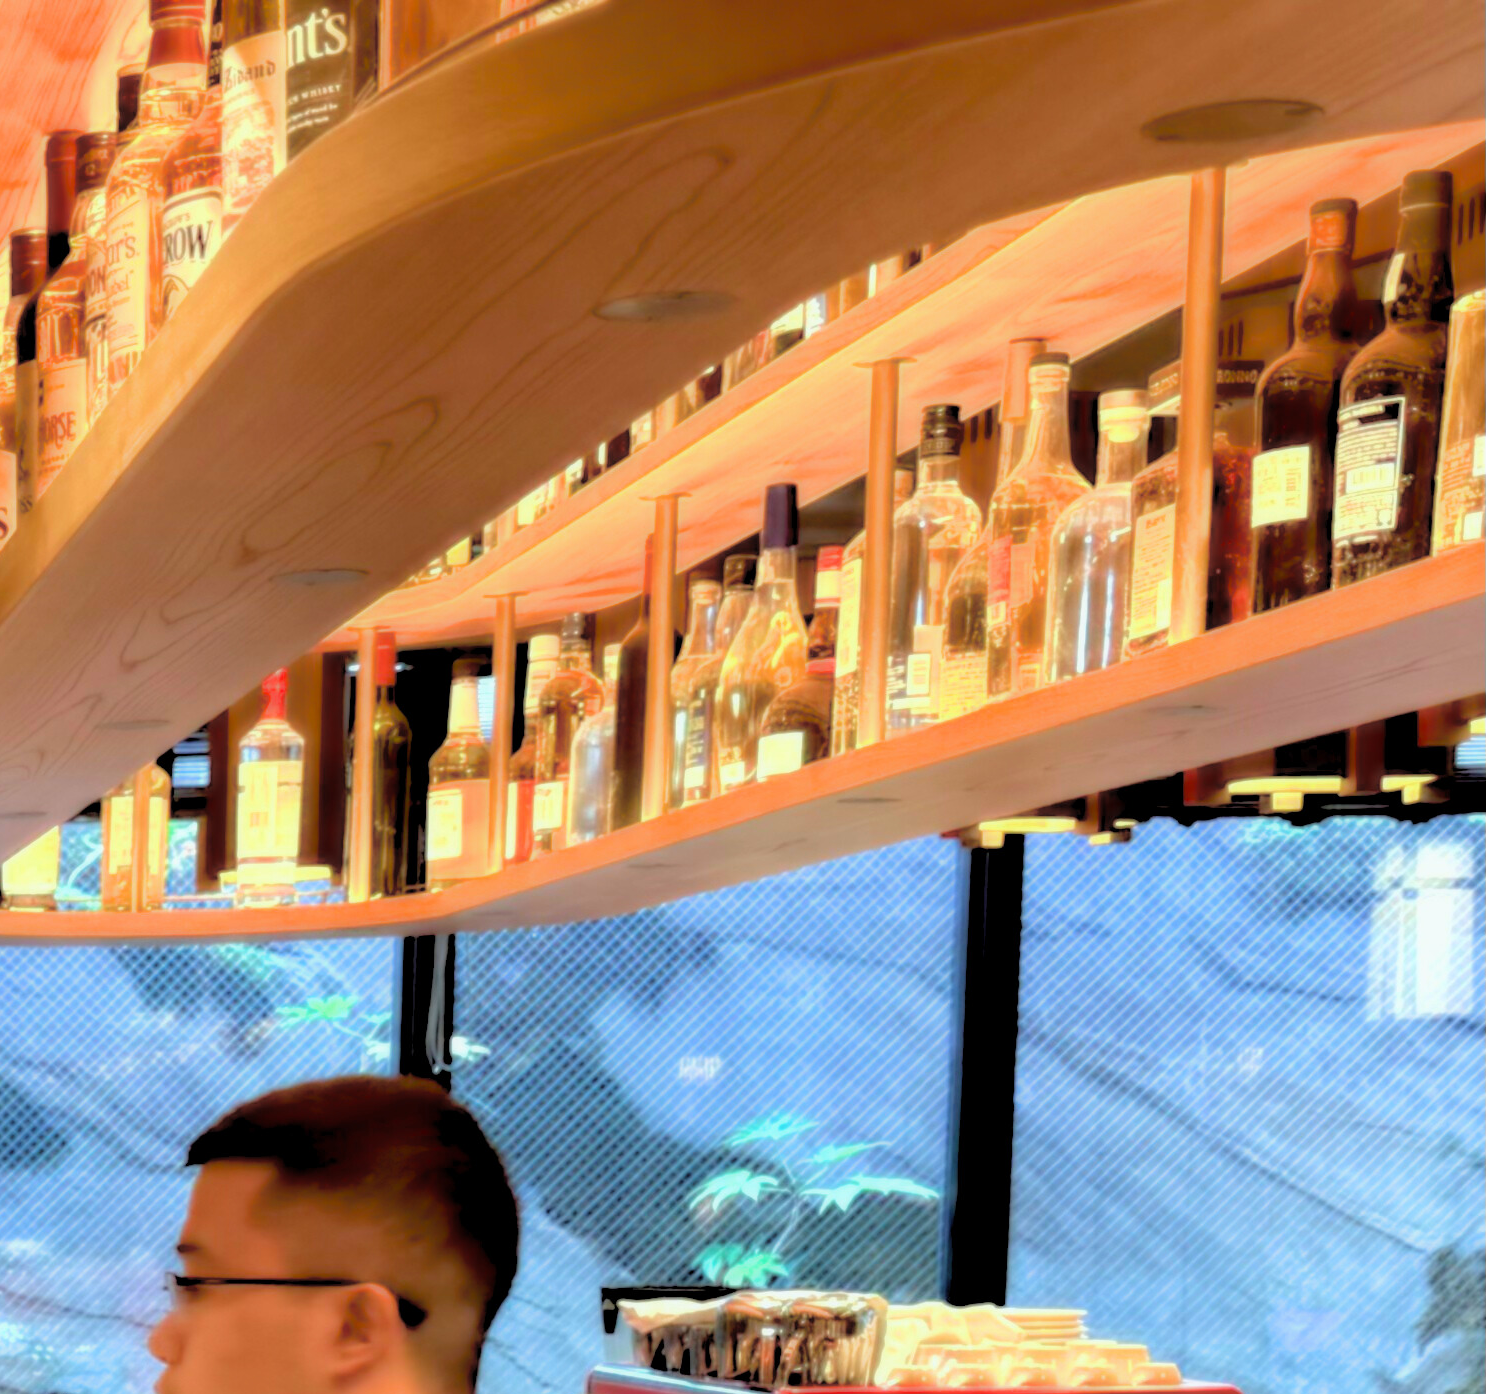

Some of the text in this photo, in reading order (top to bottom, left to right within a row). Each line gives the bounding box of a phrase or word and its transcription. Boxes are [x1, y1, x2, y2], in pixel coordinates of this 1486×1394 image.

[286, 8, 347, 68] nt's
[163, 220, 213, 265] ROW
[1216, 368, 1259, 385] RONNO
[41, 411, 77, 450] ORSE
